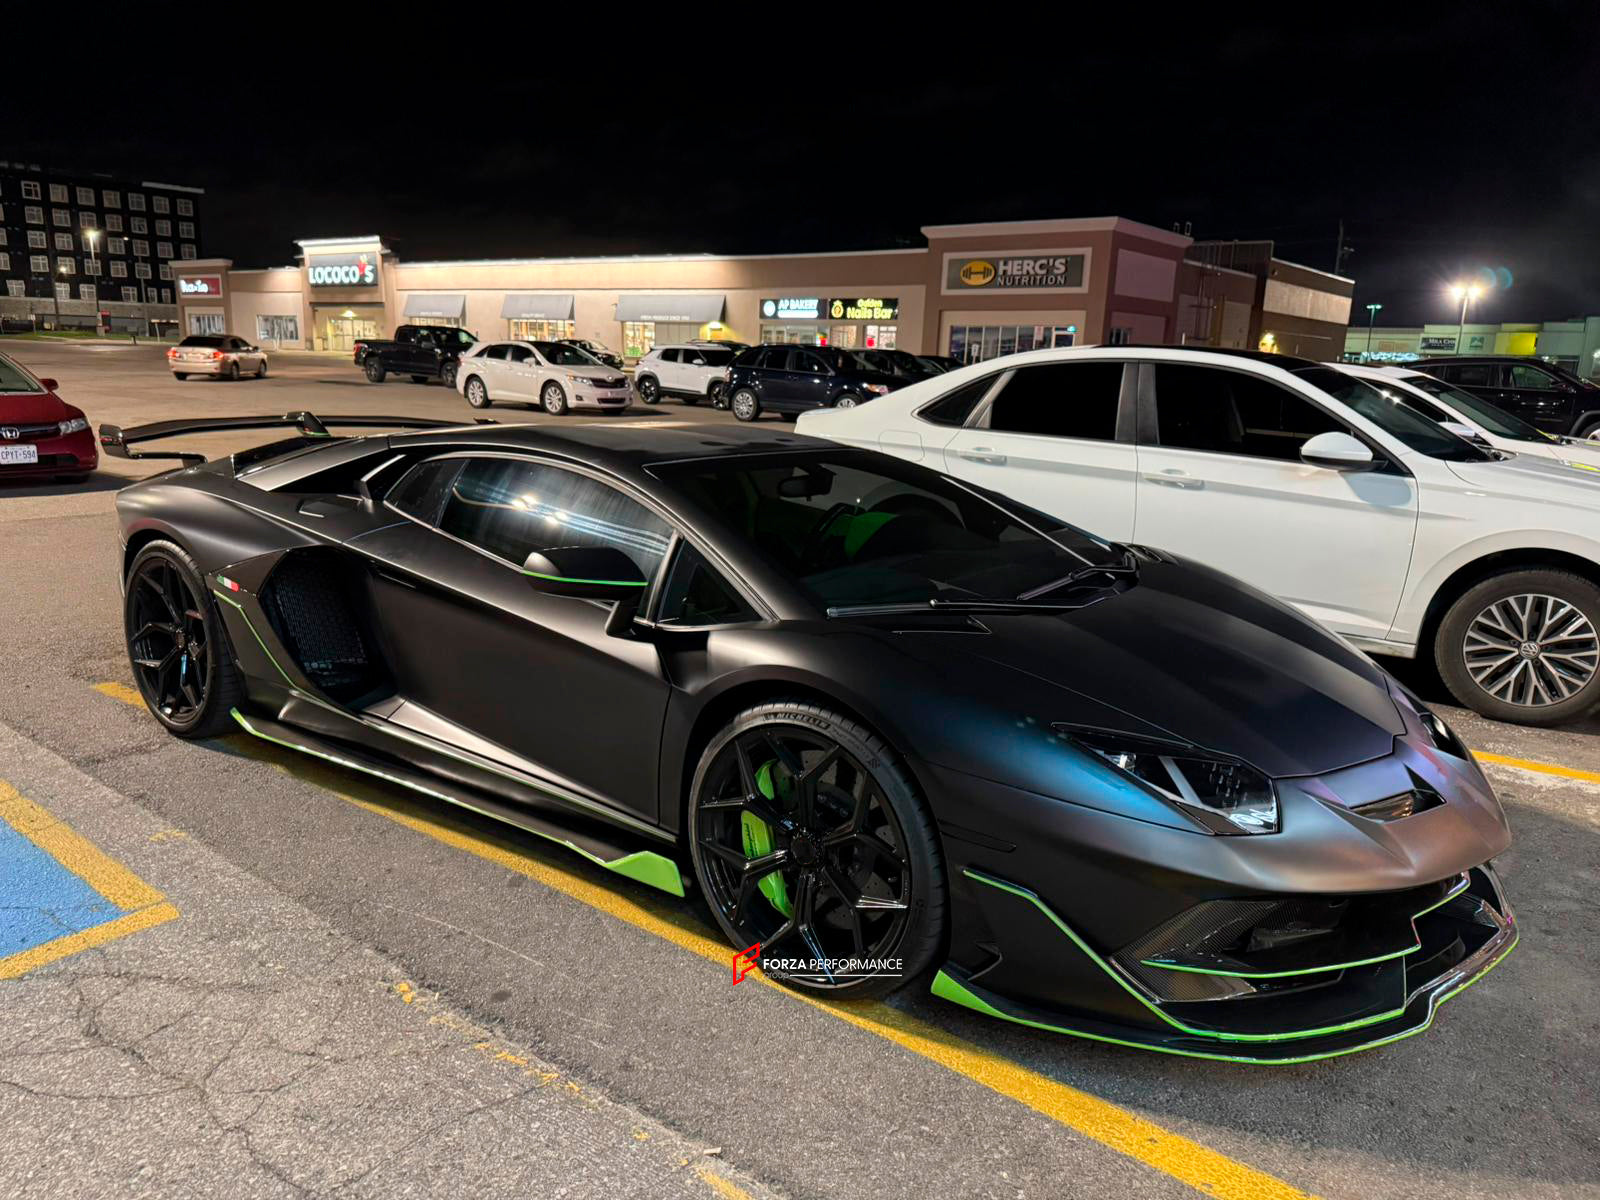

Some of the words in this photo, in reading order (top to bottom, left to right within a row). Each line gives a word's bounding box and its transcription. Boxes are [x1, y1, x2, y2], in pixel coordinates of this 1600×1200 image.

[998, 258, 1067, 275] HERC'S
[997, 275, 1066, 286] NUTRITION
[790, 299, 818, 309] BAKERY
[847, 307, 872, 319] Nails
[873, 308, 893, 319] Bar
